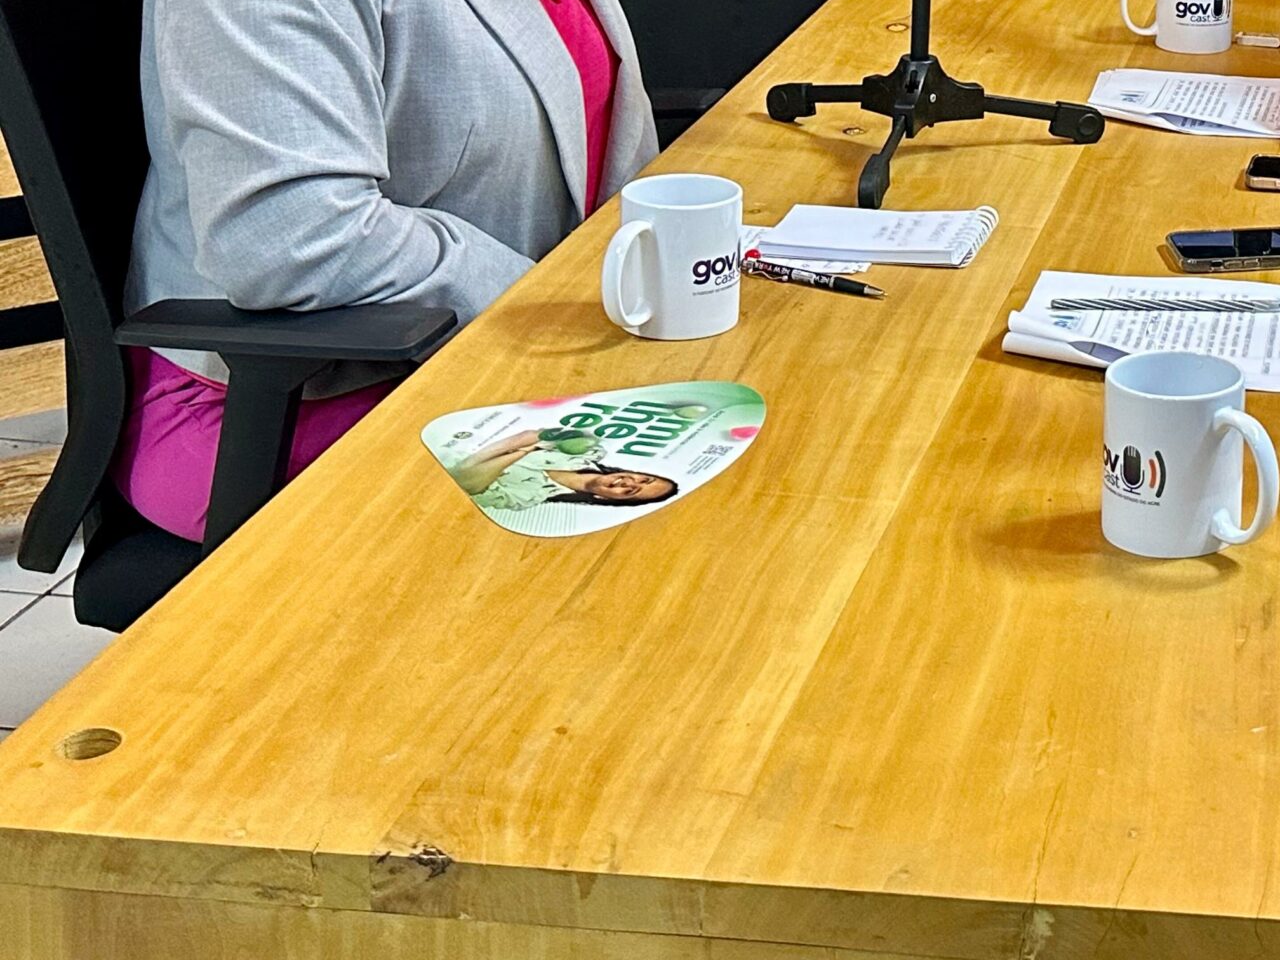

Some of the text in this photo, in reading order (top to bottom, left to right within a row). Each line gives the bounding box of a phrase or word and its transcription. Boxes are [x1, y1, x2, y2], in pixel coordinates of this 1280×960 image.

[1175, 1, 1211, 19] gov
[1190, 15, 1211, 23] cast
[692, 251, 737, 285] gov
[714, 269, 736, 286] cast
[1103, 442, 1120, 473] ov
